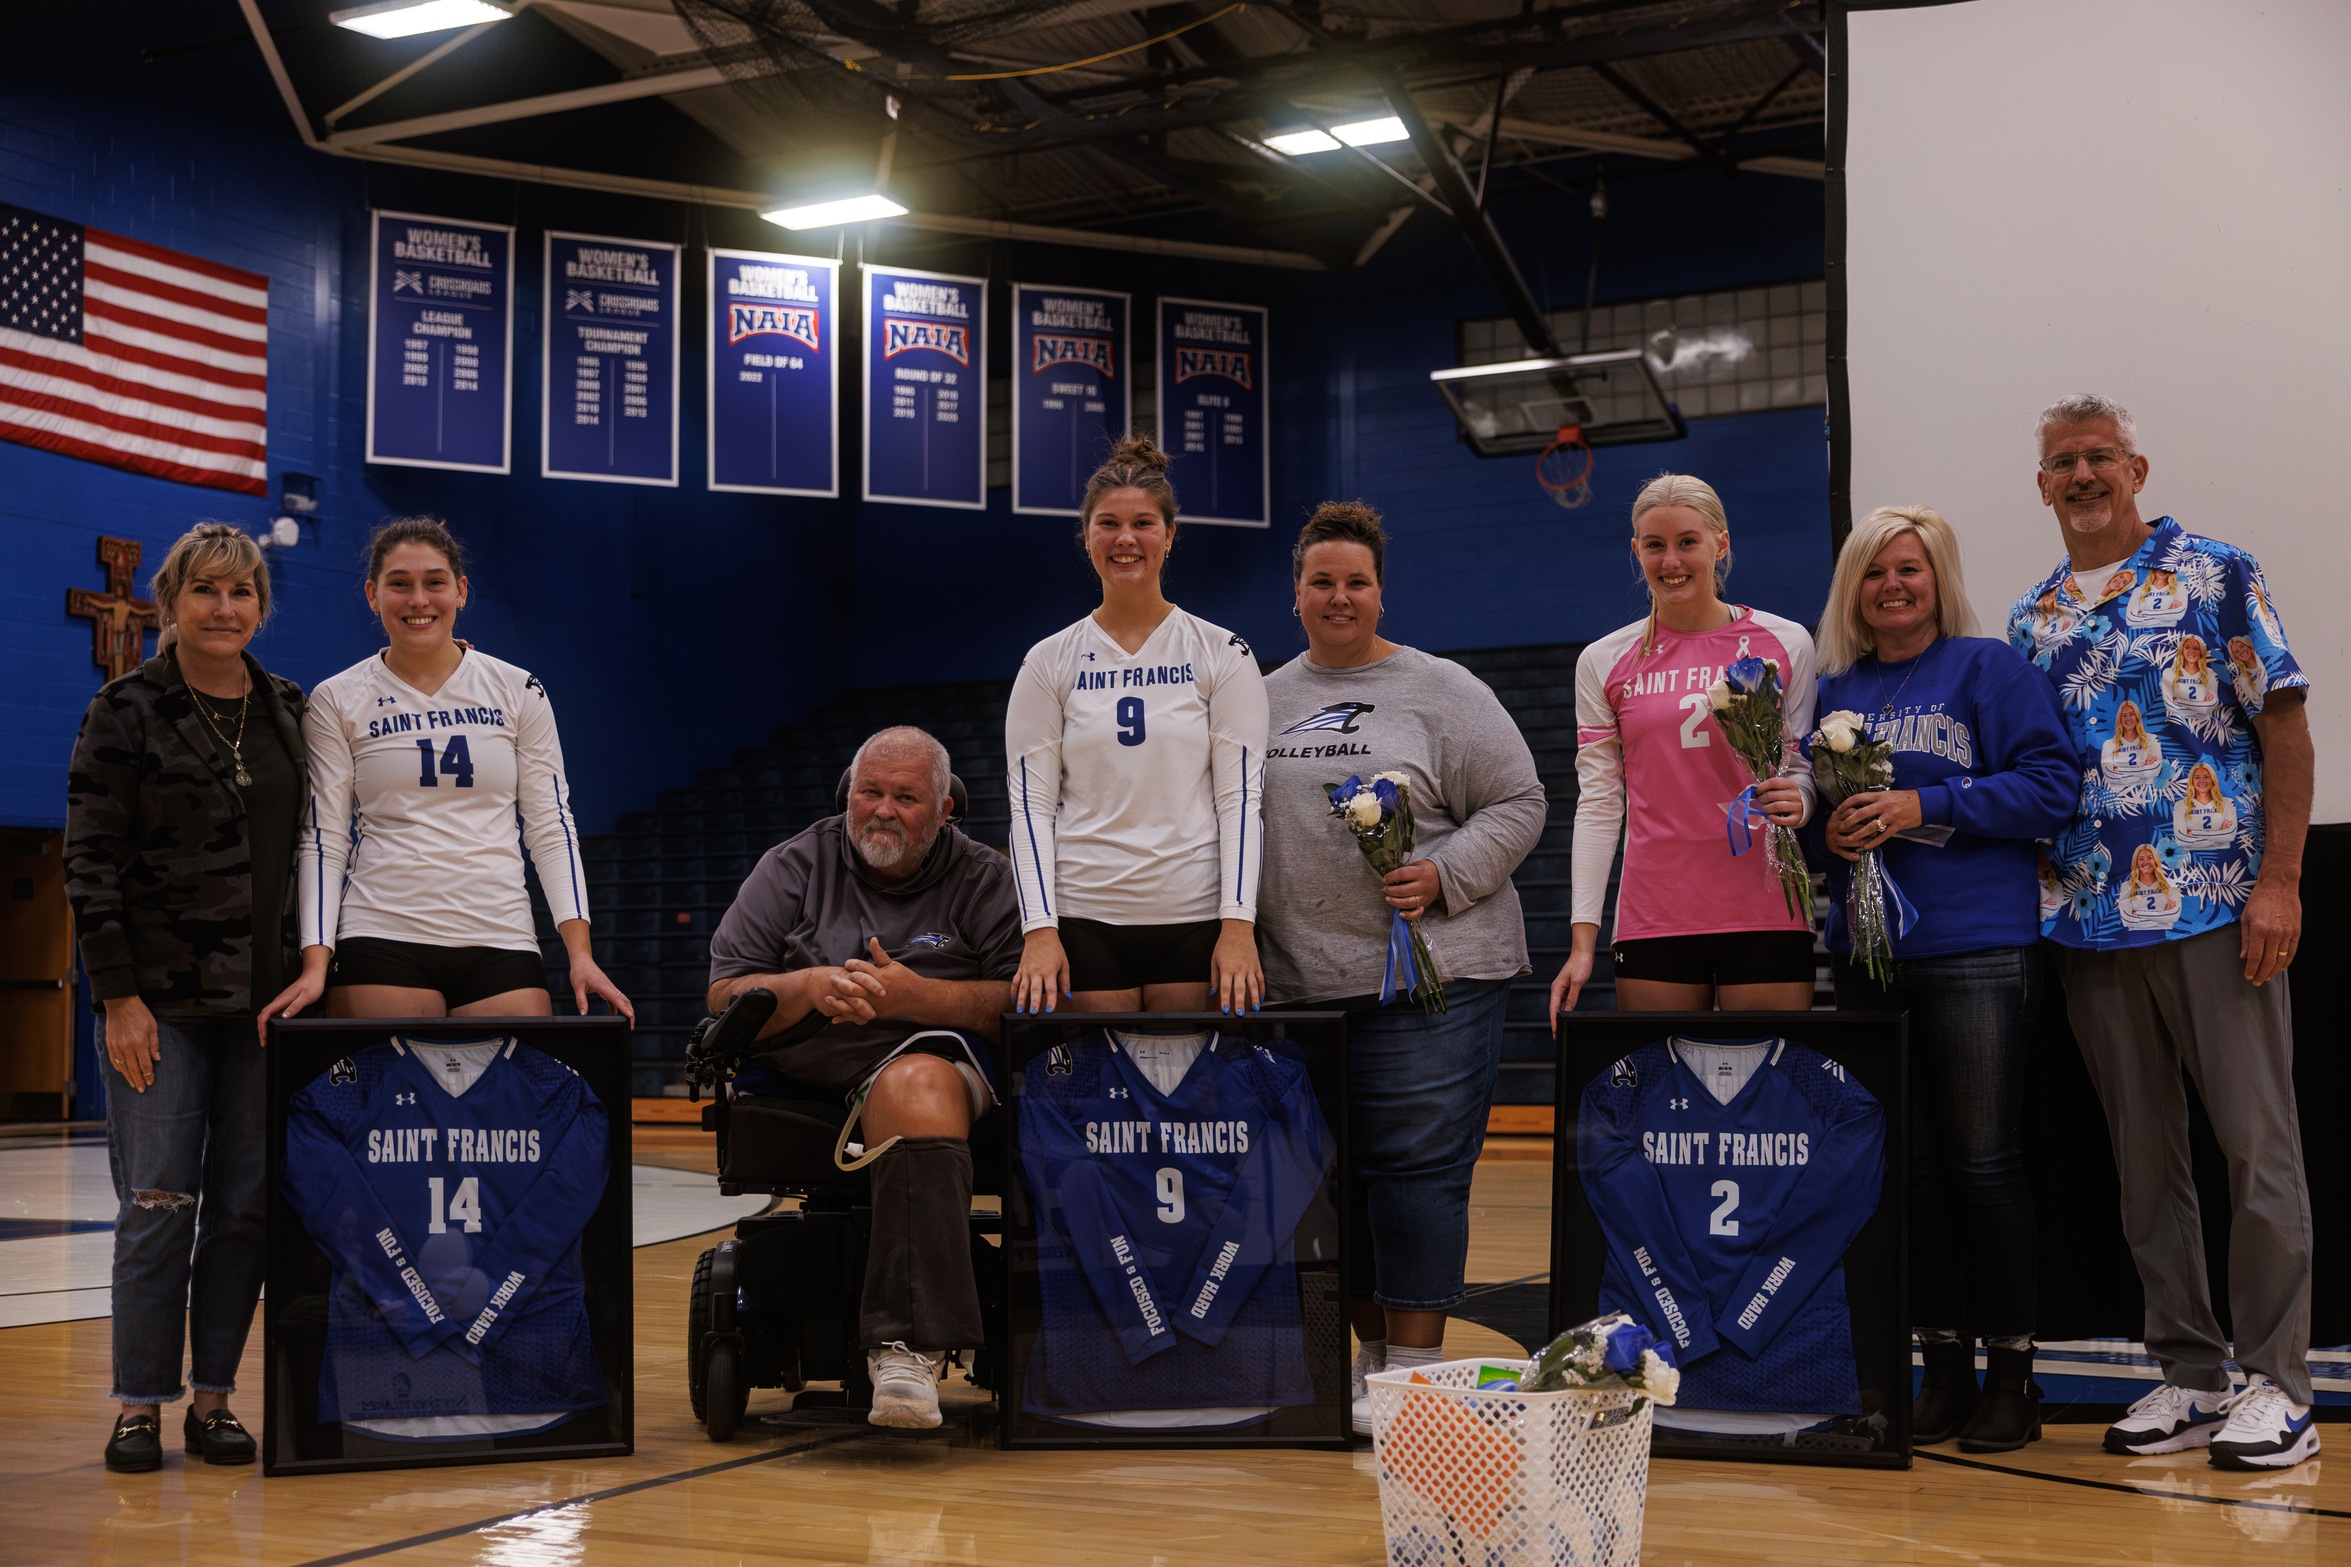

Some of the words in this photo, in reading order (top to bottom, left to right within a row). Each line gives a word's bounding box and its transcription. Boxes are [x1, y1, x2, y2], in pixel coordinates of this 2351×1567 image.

[408, 228, 481, 250] WOMEN'S
[394, 242, 492, 268] BASKETBALL
[578, 248, 649, 270] WOMEN'S
[428, 275, 492, 295] CROSSROADS
[566, 262, 660, 286] BASKETBALL
[739, 265, 808, 285] WOMEN'S
[728, 279, 818, 302] BASKETBALL
[894, 282, 959, 302] WOMEN'S
[599, 294, 659, 312] CROSSROADS
[883, 294, 968, 318] BASKETBALL
[1043, 298, 1104, 316] WOMEN'S
[422, 310, 464, 325] LEAGUE
[731, 306, 818, 350] NAIA
[1032, 311, 1113, 332] BASKETBALL
[1184, 312, 1242, 330] WOMEN'S
[413, 322, 472, 340] CHAMPION
[576, 326, 648, 344] TOURNAMENT
[1174, 324, 1251, 345] BASKETBALL
[584, 340, 641, 356] CHAMPION
[886, 322, 968, 365] NAIA
[744, 354, 774, 367] FIELD
[774, 356, 789, 368] OF
[790, 357, 804, 370] 64
[1035, 336, 1114, 378] NAIA
[894, 368, 928, 382] ROUND
[930, 370, 943, 383] OF
[944, 372, 958, 385] 32
[1178, 350, 1251, 389] NAIA
[1052, 382, 1084, 396] SWEET
[2153, 598, 2162, 610] 2
[1073, 670, 1118, 690] AINT
[1123, 663, 1194, 688] FRANCIS
[1623, 669, 1679, 699] SAINT
[1686, 666, 1725, 690] FRA
[2189, 686, 2196, 700] 2
[370, 713, 422, 738] SAINT
[428, 707, 504, 729] FRANCIS
[1117, 696, 1146, 746] 9
[1679, 693, 1710, 748] 2
[1868, 706, 1921, 721] ERSITY
[1931, 703, 1944, 712] OF
[416, 735, 474, 788] 14
[1266, 743, 1371, 758] OLLEYBALL
[2128, 753, 2136, 766] 2
[2203, 816, 2212, 829] 2
[2147, 896, 2156, 910] 2
[368, 1128, 437, 1162] SAINT
[448, 1128, 540, 1162] FRANCIS
[1086, 1122, 1151, 1154] SAINT
[1160, 1121, 1248, 1154] FRANCIS
[1642, 1131, 1708, 1165] SAINT
[1719, 1132, 1808, 1166] FRANCIS
[428, 1177, 482, 1234] 14
[1156, 1168, 1185, 1224] 9
[1710, 1180, 1739, 1236] 2
[376, 1228, 402, 1259] FUN
[1110, 1235, 1134, 1265] FUN
[396, 1258, 406, 1267] &
[1126, 1266, 1136, 1274] &
[1210, 1240, 1240, 1280] WORK
[1633, 1246, 1658, 1277] FUN
[1651, 1276, 1662, 1286] &
[1762, 1256, 1796, 1296] WORK
[401, 1267, 445, 1324] FOCUSED
[490, 1270, 526, 1310] WORK
[1190, 1280, 1220, 1319] HARD
[1130, 1276, 1166, 1336] FOCUSED
[1738, 1292, 1769, 1330] HARD
[466, 1307, 498, 1344] HARD
[1655, 1288, 1691, 1349] FOCUSED
